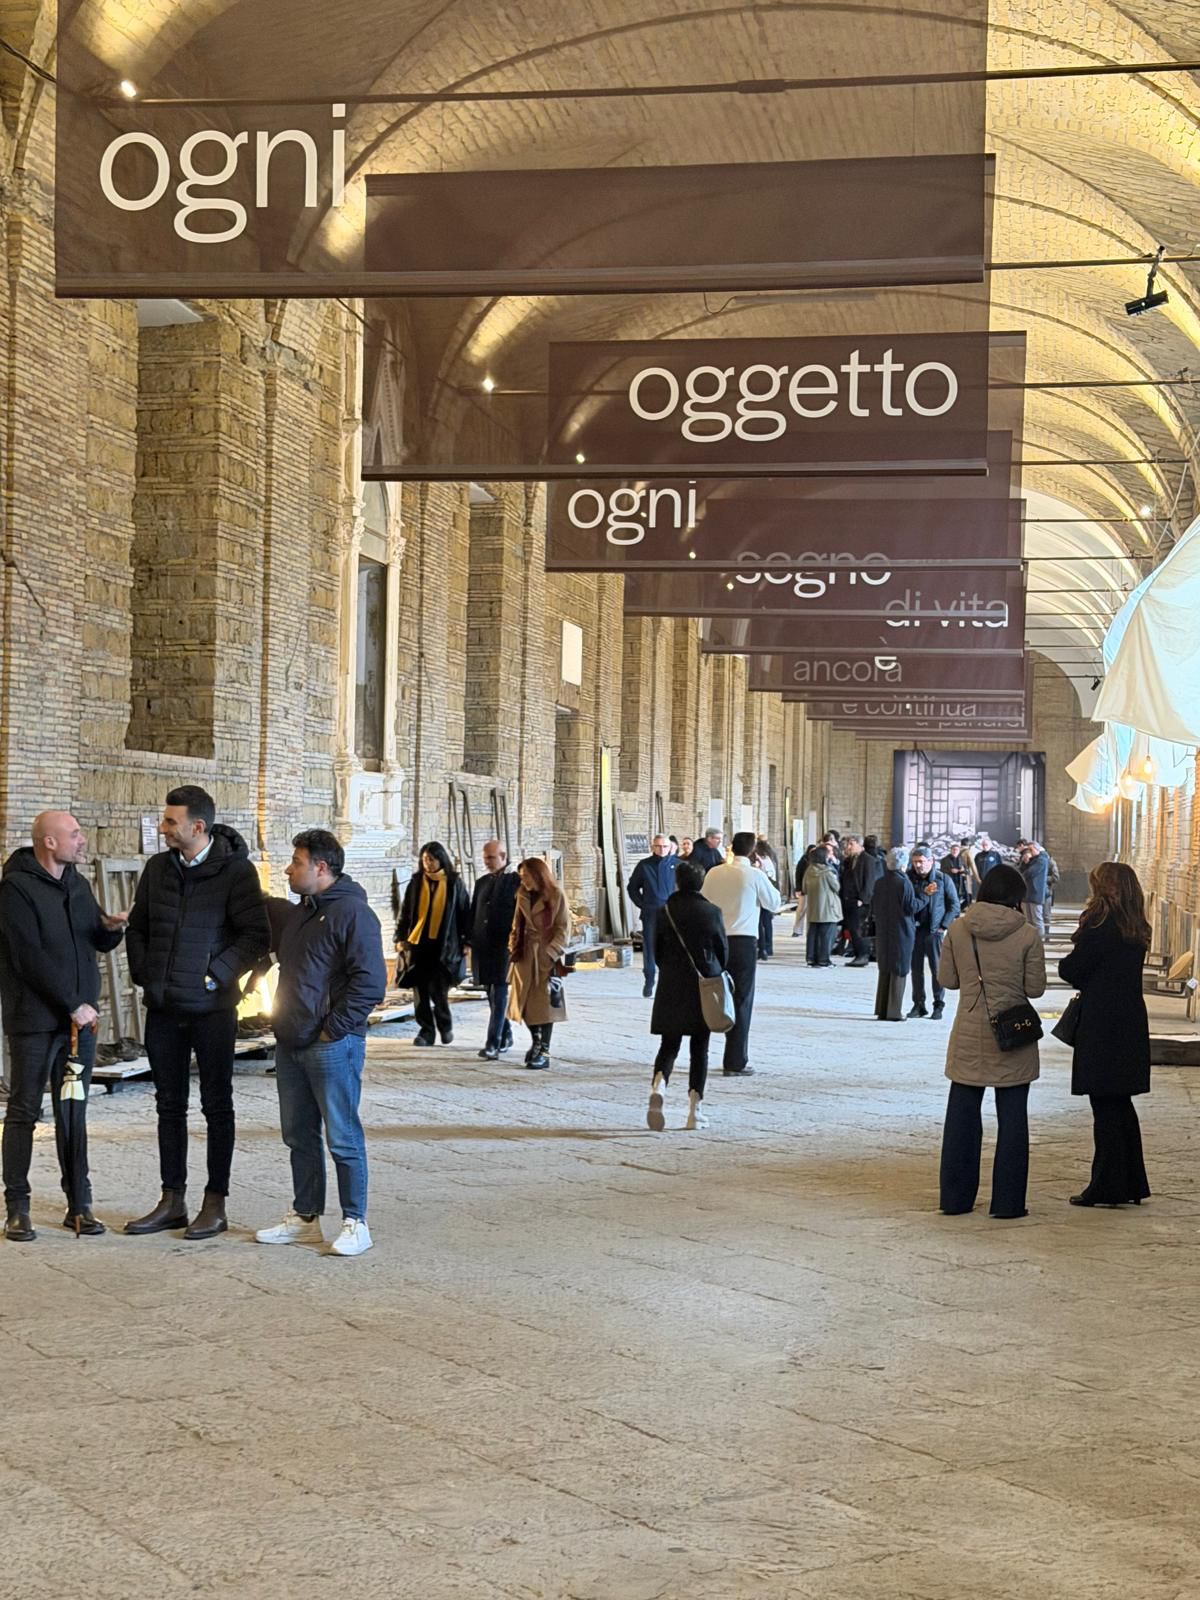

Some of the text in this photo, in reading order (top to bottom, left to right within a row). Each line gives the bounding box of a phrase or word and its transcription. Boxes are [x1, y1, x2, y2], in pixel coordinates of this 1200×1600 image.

[99, 103, 346, 244] ogni
[629, 348, 959, 443] oggetto
[567, 480, 697, 546] ogni
[736, 551, 891, 598] segno
[885, 589, 1008, 627] di vita
[793, 659, 902, 682] ancora
